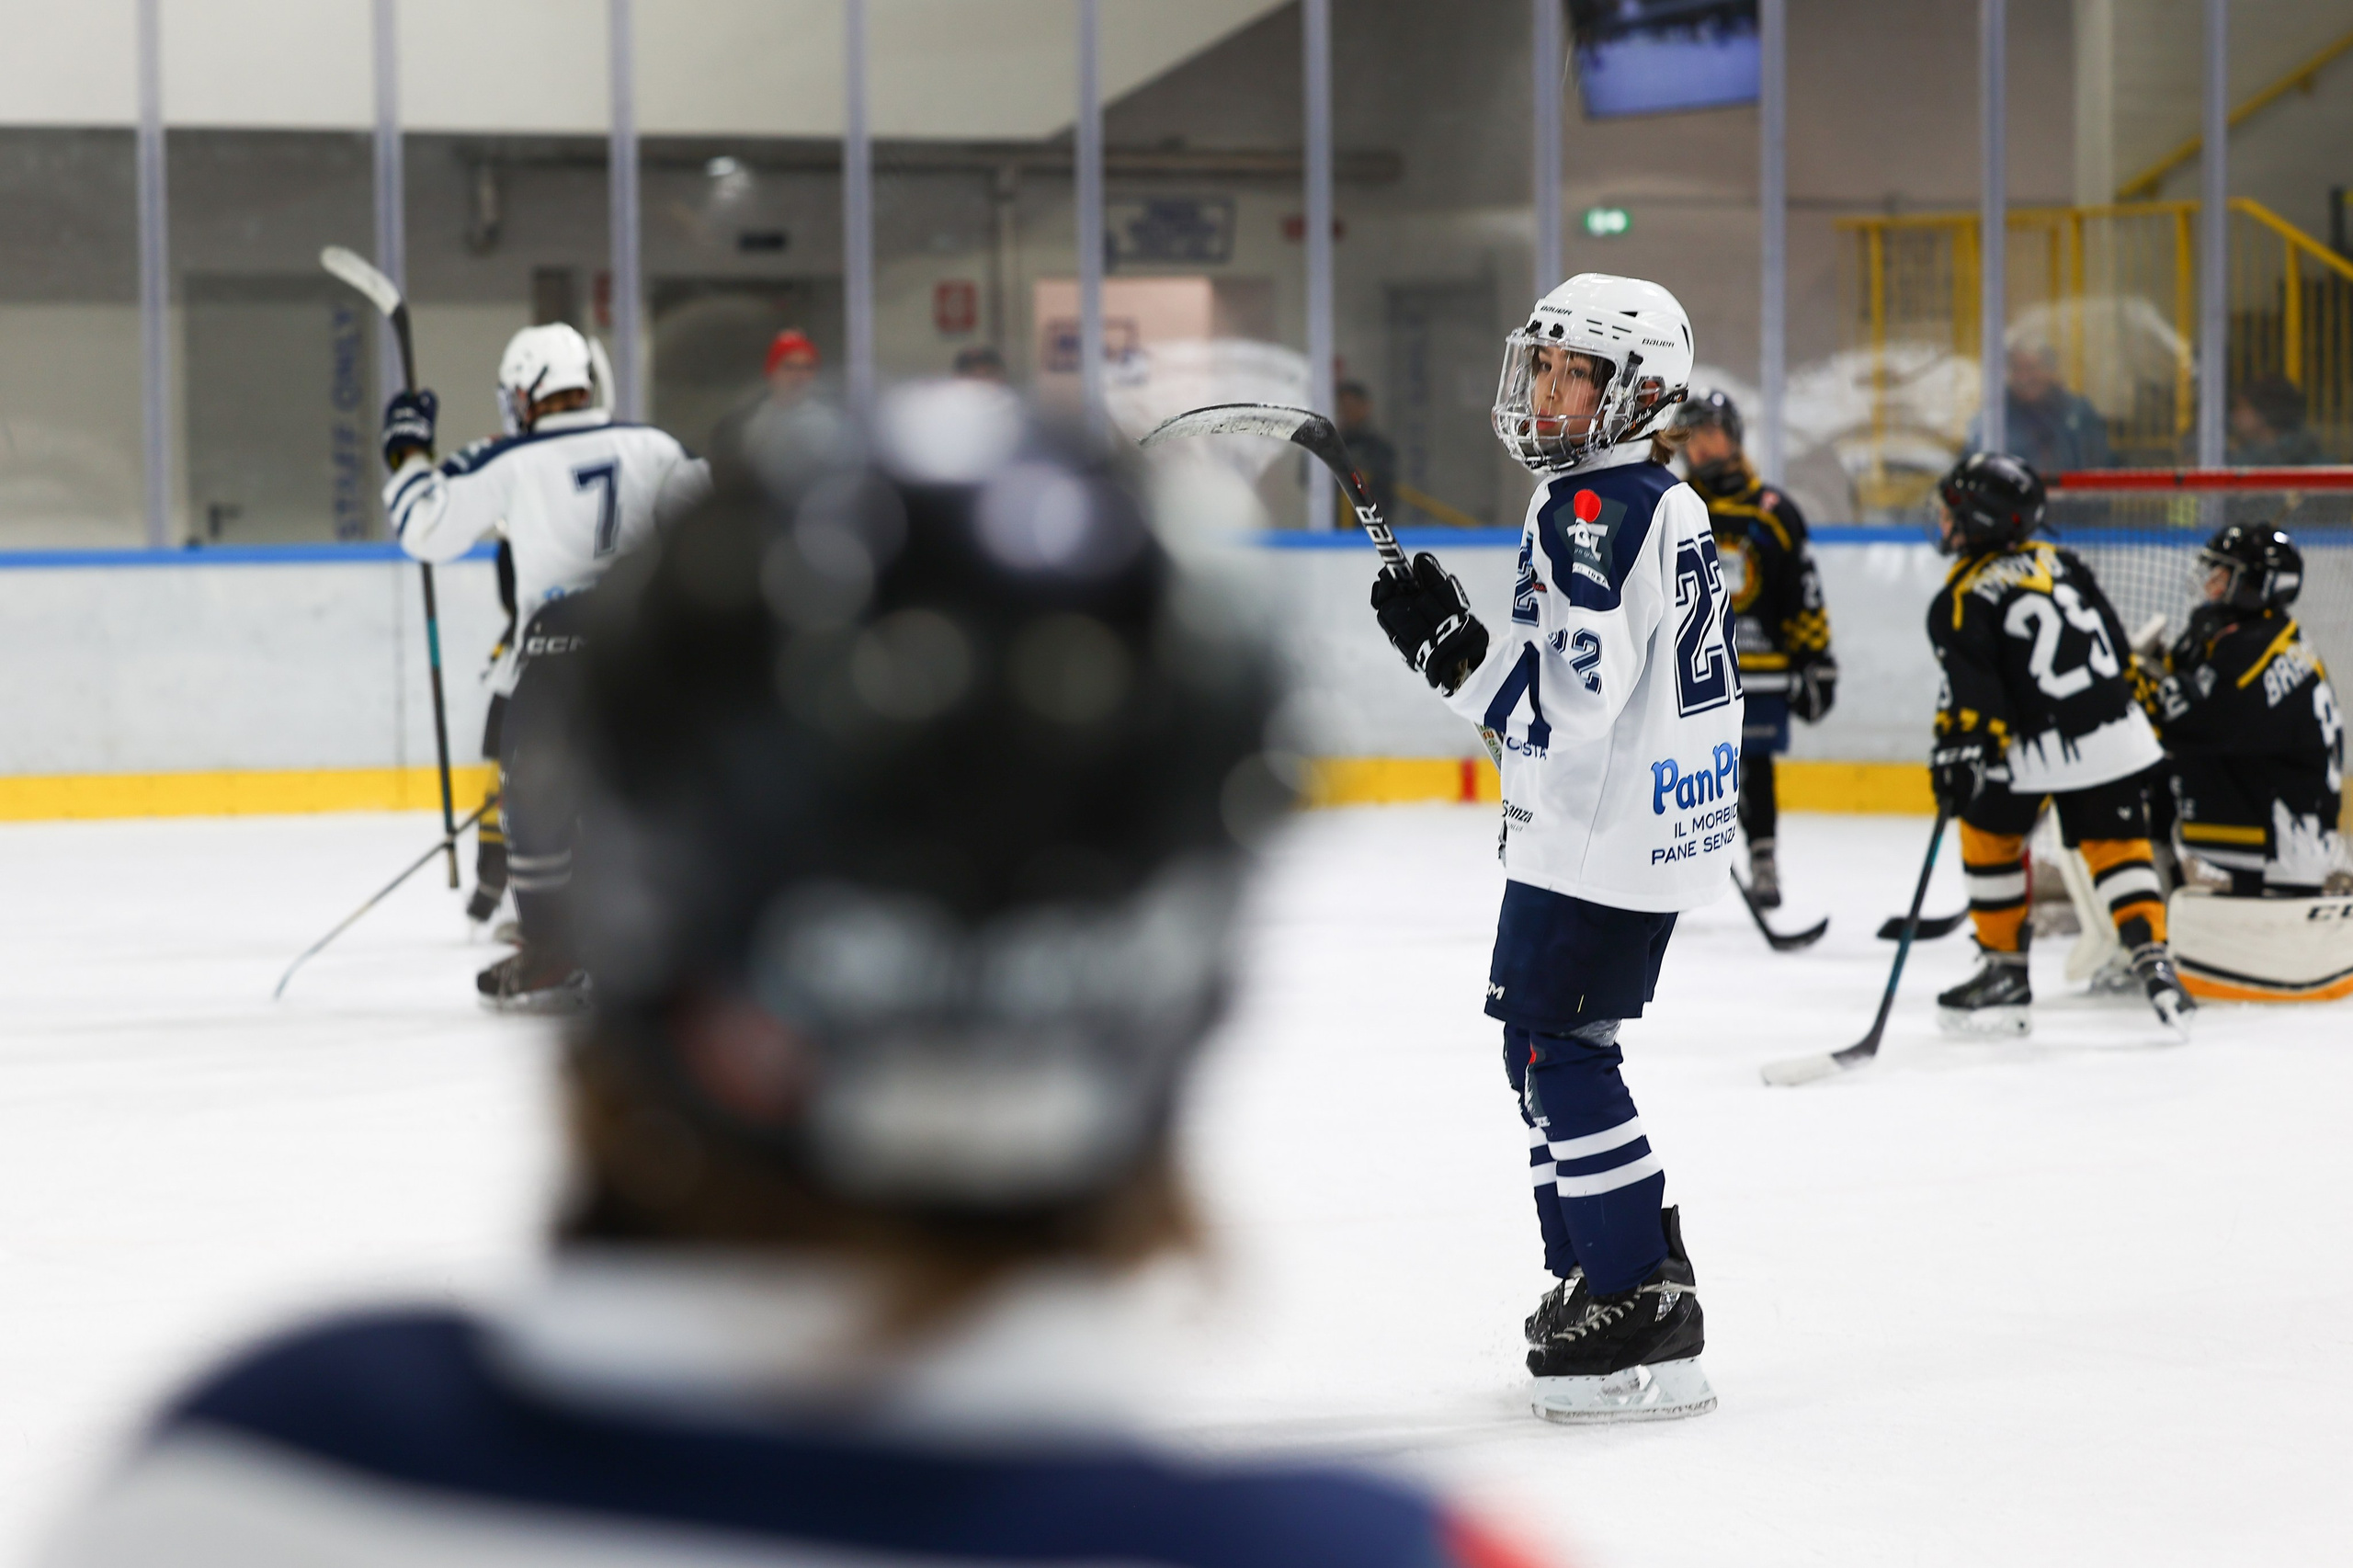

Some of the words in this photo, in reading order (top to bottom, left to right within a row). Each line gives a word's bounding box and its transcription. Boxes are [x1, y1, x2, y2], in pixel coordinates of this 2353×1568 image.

[1540, 304, 1573, 316] BAUER
[1641, 337, 1675, 348] BAUER
[572, 456, 621, 559] 7
[1356, 502, 1418, 582] AUER
[1675, 530, 1745, 719] 22
[1674, 822, 1687, 838] IL
[1652, 840, 1697, 866] PANE
